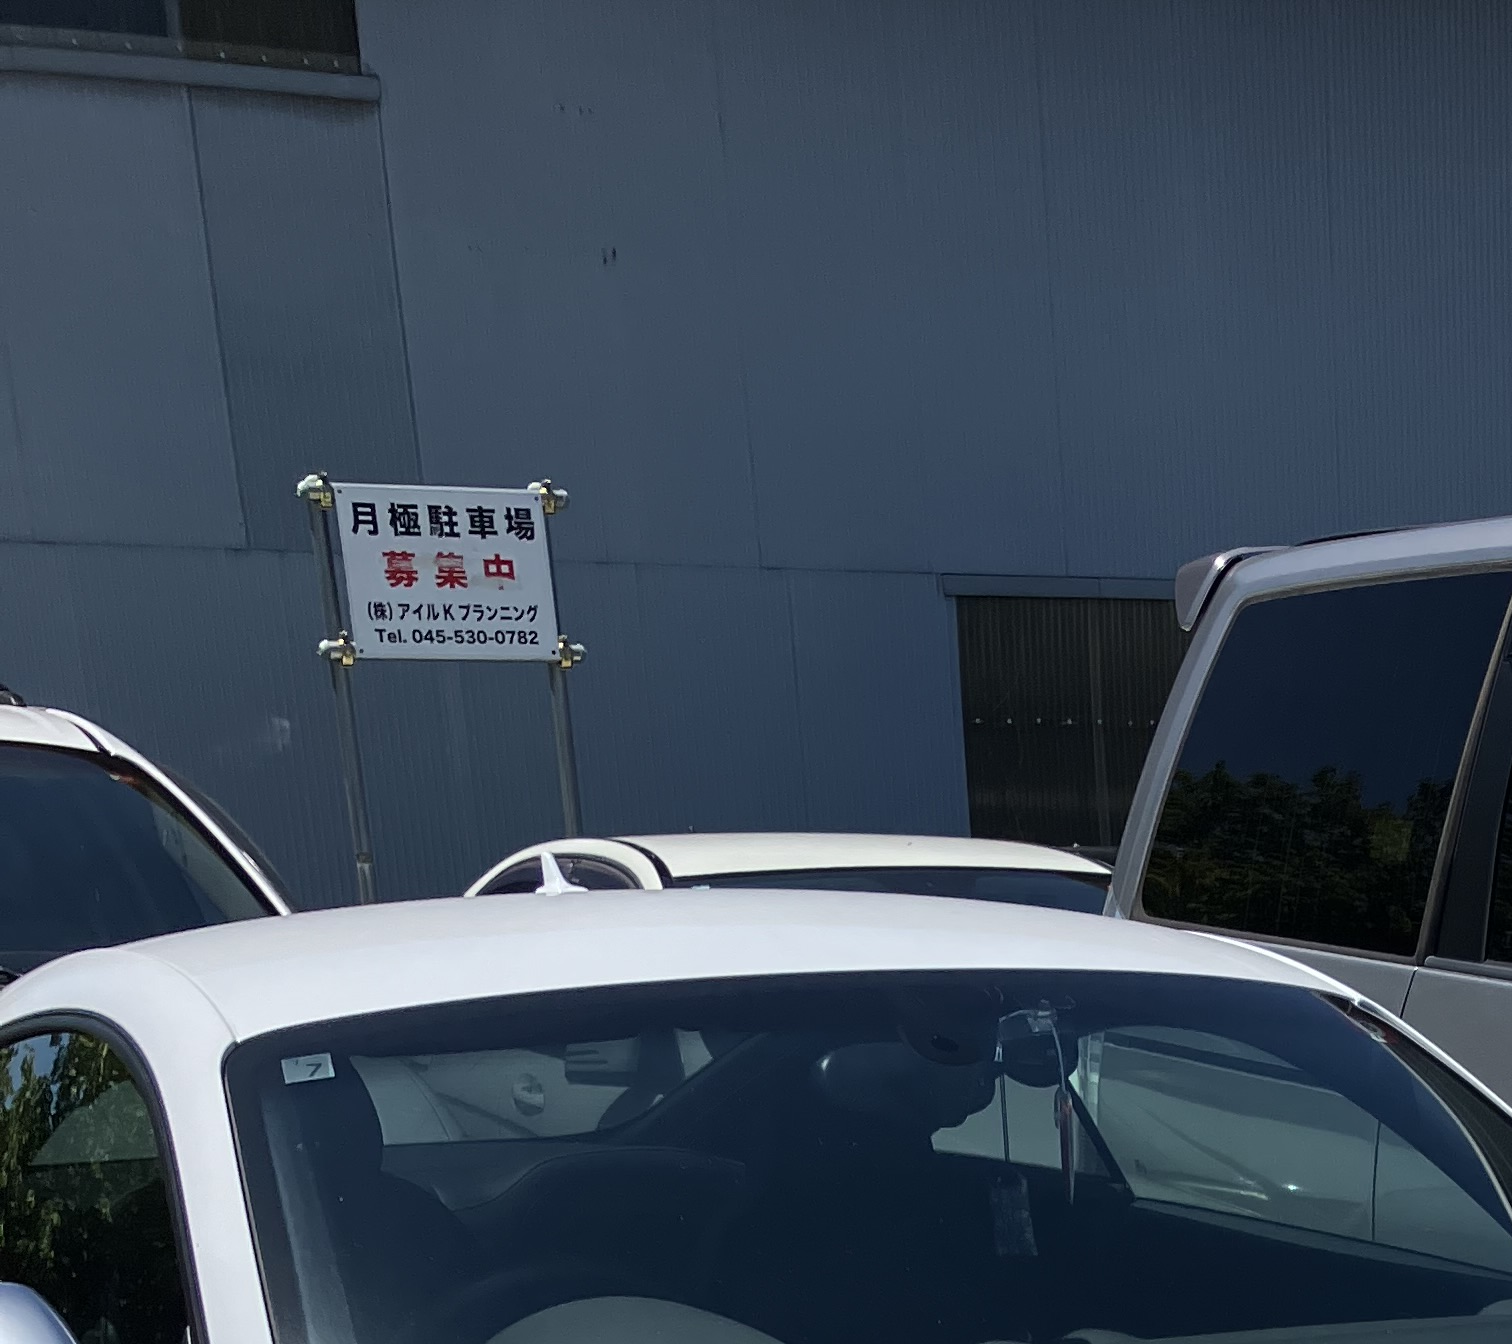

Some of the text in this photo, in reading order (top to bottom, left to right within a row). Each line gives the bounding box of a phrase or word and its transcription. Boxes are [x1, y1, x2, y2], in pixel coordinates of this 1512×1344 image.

[351, 502, 535, 541] 月極駐車場
[382, 550, 516, 590] 募集中
[374, 628, 539, 645] Tel. 045-530-0782
